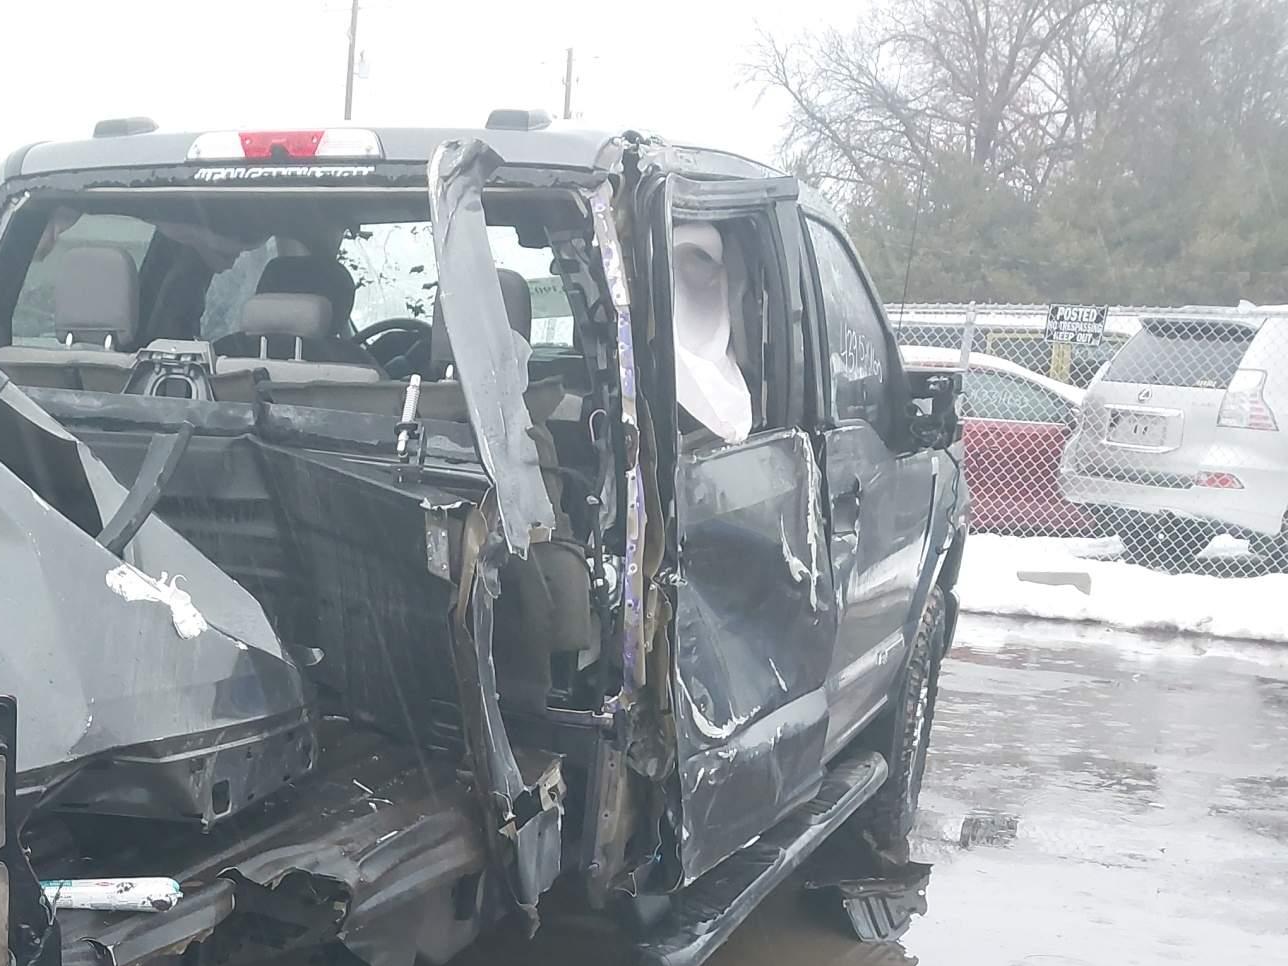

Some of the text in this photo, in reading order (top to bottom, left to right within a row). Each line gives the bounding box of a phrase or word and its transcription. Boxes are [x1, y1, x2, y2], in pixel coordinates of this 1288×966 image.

[1057, 307, 1097, 321] POSTED
[1048, 320, 1103, 333] NO TRESPASSING
[1053, 332, 1093, 343] KEEP OUT
